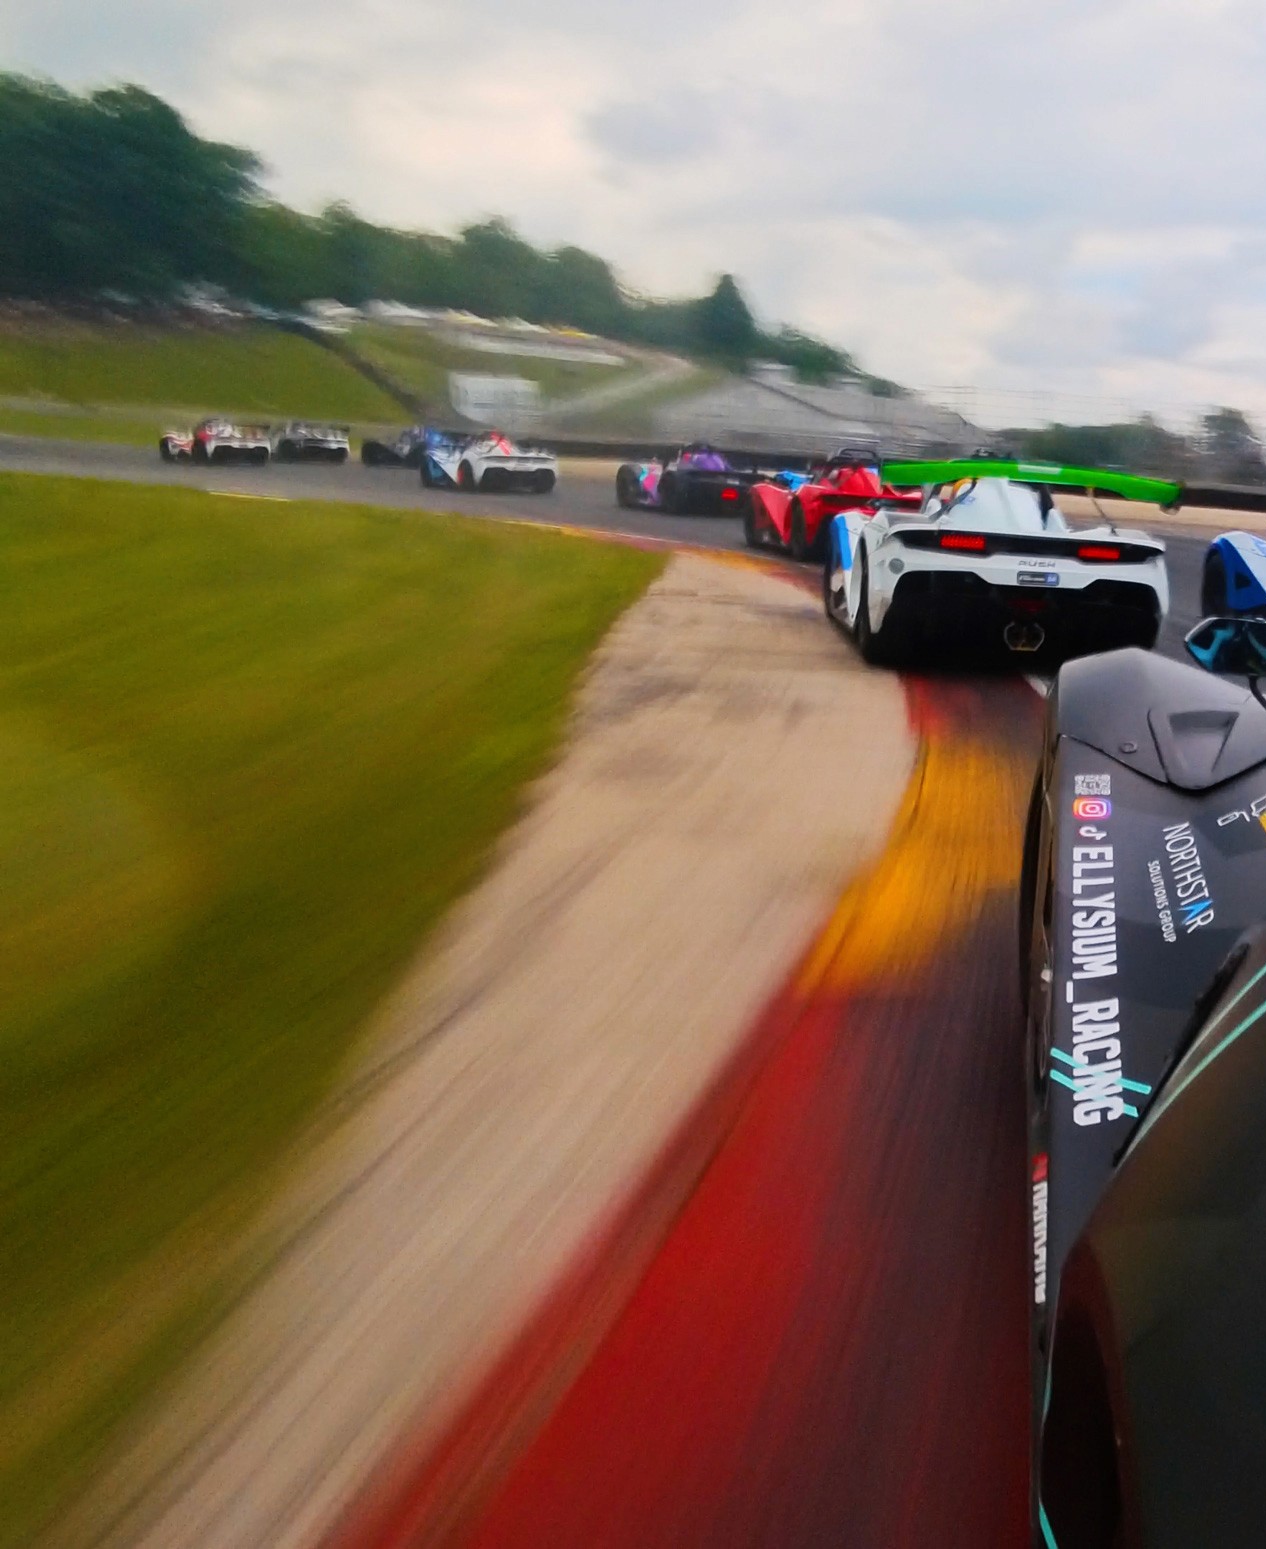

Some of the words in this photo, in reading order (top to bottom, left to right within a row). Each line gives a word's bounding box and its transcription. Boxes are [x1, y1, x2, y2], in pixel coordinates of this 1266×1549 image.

[1148, 861, 1168, 908] SOLUTIONS
[1159, 909, 1177, 943] GROUP
[1163, 821, 1214, 933] NORTHSTAR
[1066, 846, 1124, 1127] ELLYSIUM_RACING
